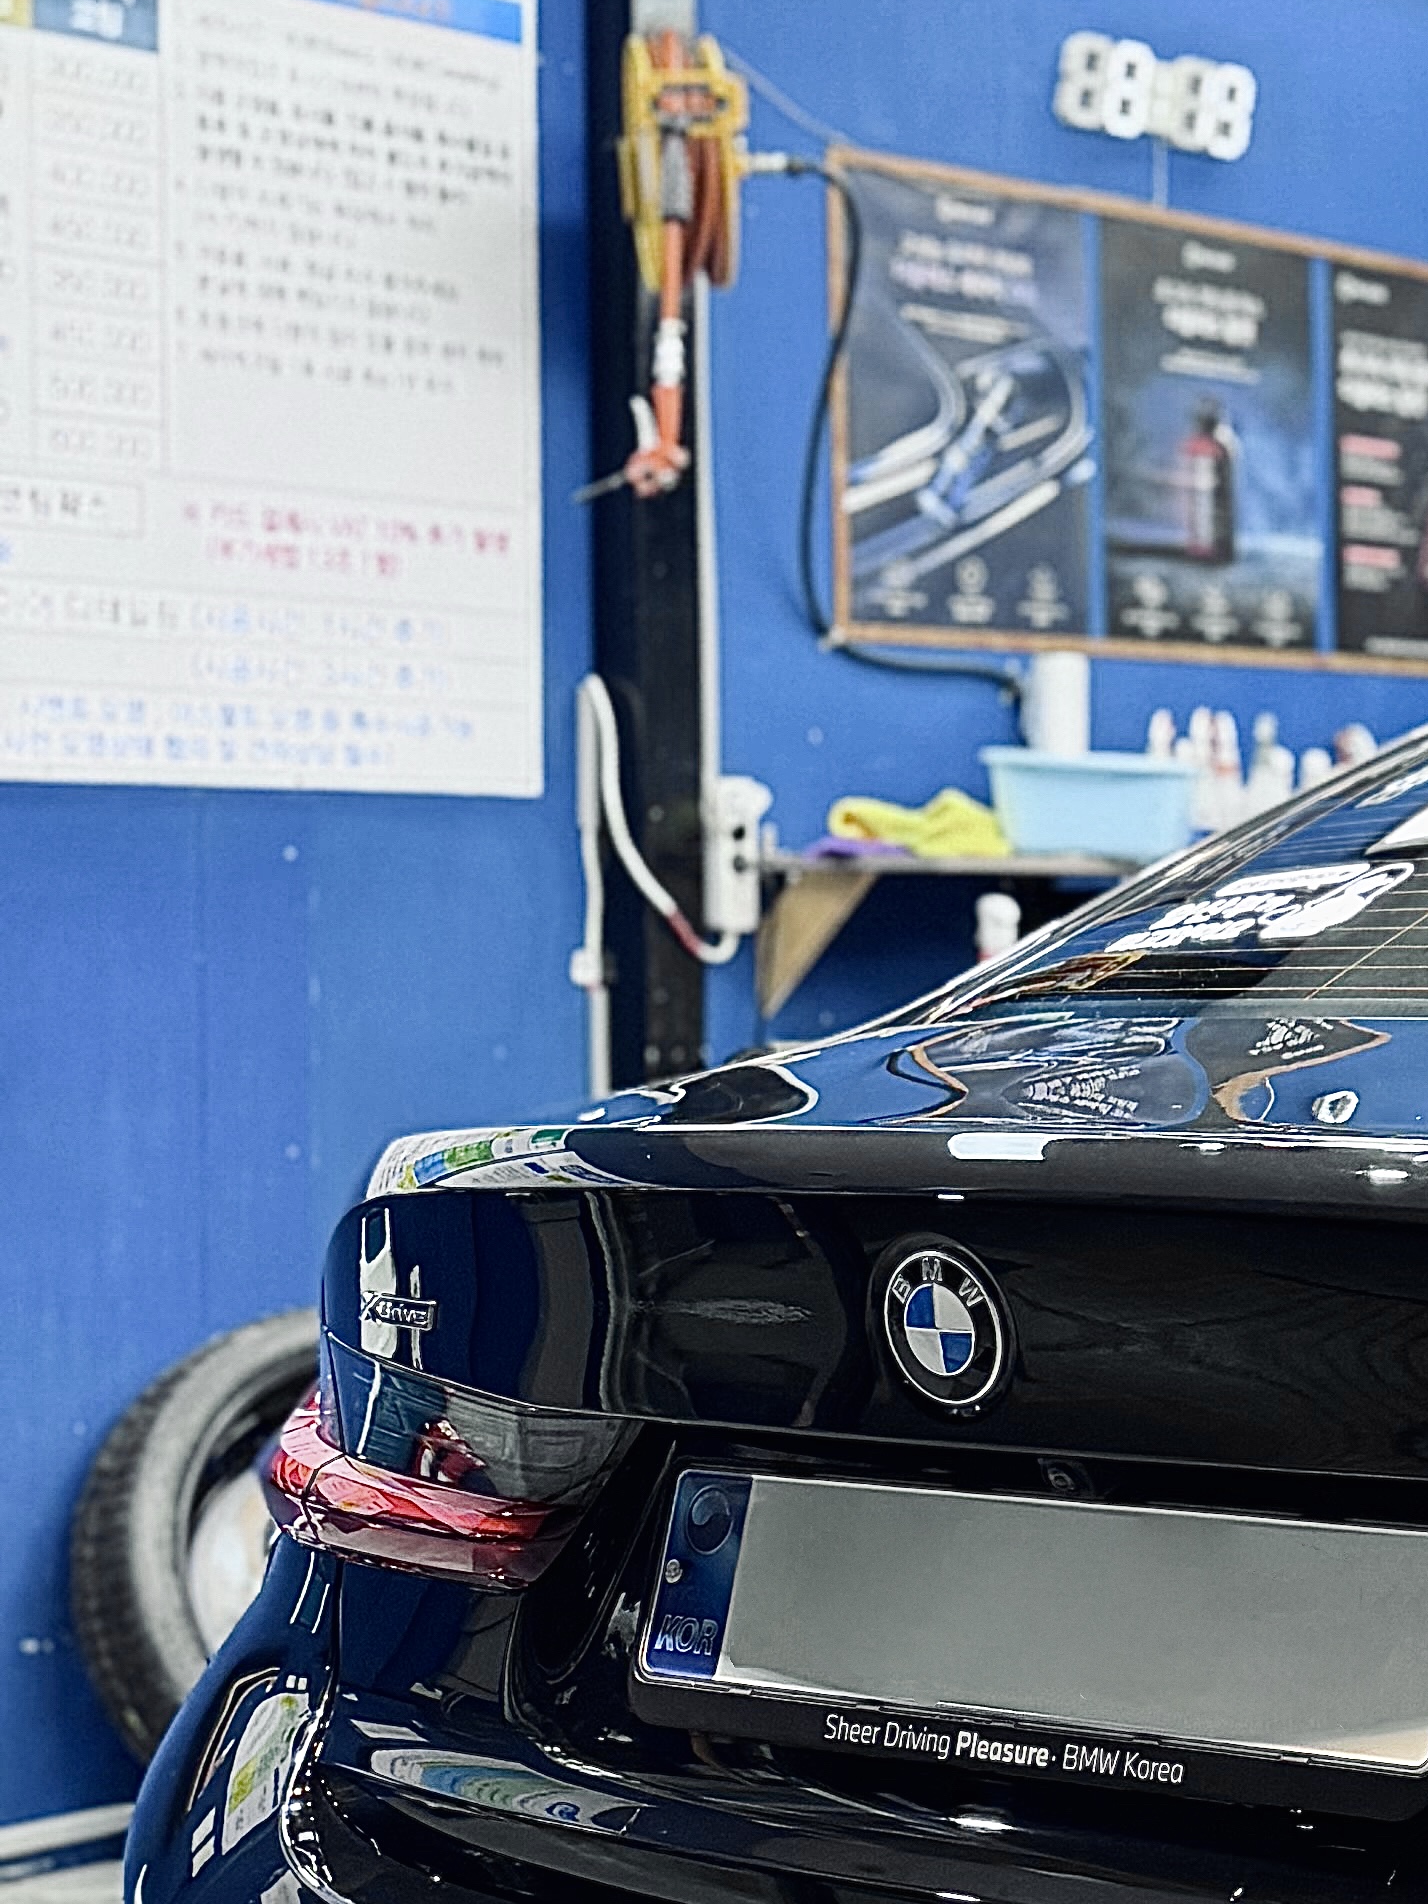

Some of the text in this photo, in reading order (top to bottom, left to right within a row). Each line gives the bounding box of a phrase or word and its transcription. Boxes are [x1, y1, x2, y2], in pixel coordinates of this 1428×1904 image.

[891, 1256, 986, 1307] BMW
[654, 1614, 719, 1656] KOR
[823, 1713, 881, 1745] Sheer
[883, 1721, 951, 1760] Driving
[1062, 1743, 1120, 1775] BMW
[1123, 1751, 1185, 1784] Korea
